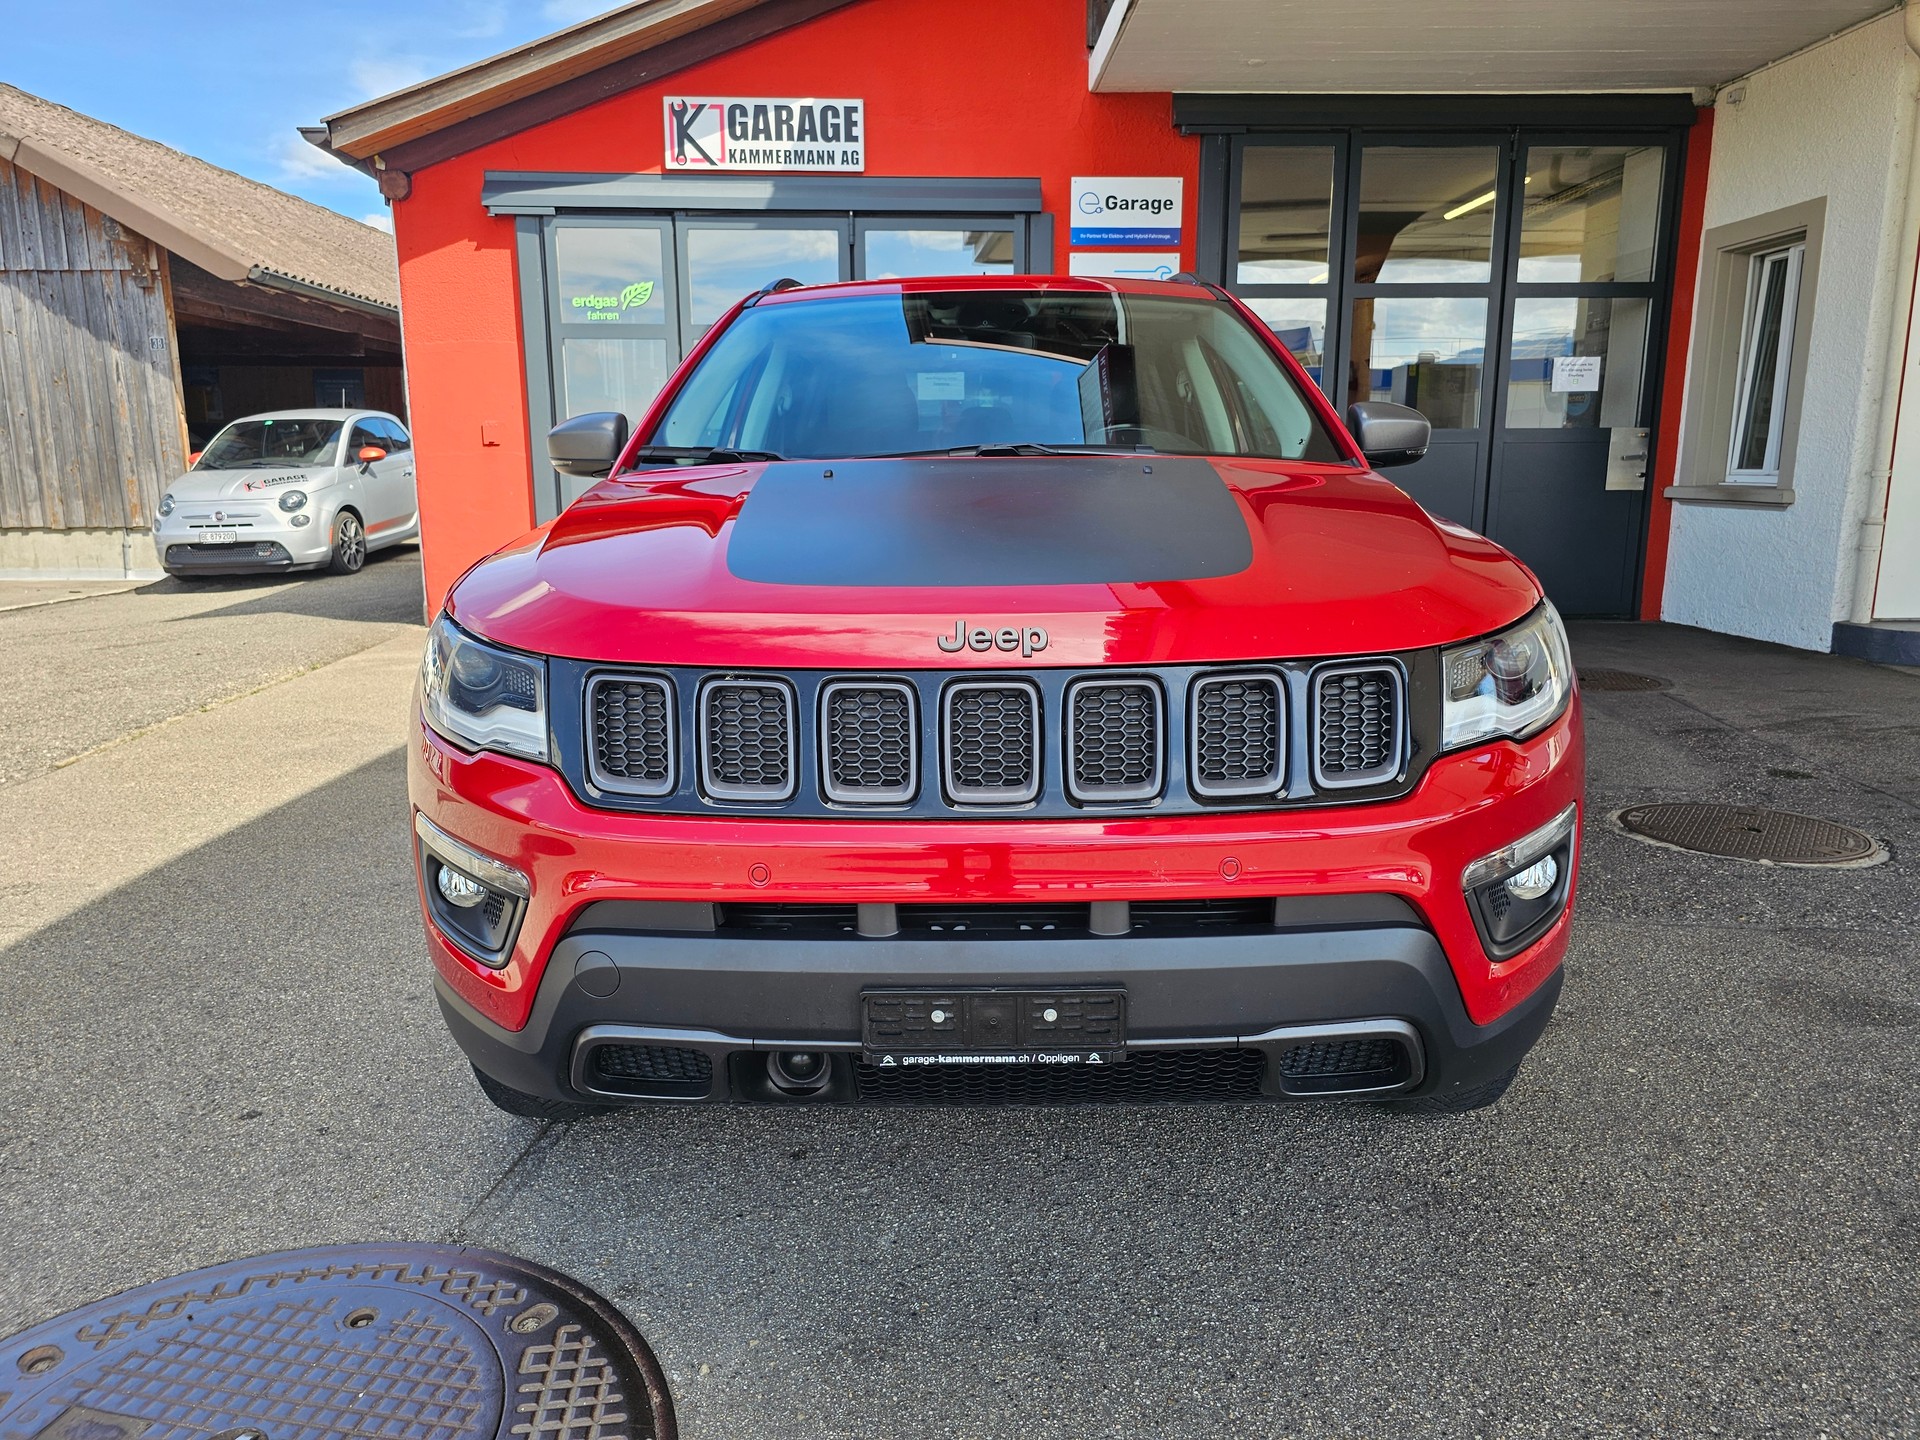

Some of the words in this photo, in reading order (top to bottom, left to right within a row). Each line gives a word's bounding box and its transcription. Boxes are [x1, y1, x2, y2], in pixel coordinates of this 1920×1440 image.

[727, 103, 859, 143] GARAGE
[728, 148, 836, 166] KAMMERMANN
[840, 149, 860, 166] AG
[572, 294, 619, 310] erdgas
[587, 310, 620, 321] fahren
[263, 474, 308, 484] GARAGE
[937, 620, 1049, 658] Jeep
[902, 1053, 1030, 1066] garage-kammermann.ch
[1037, 1053, 1080, 1065] Oppligen
